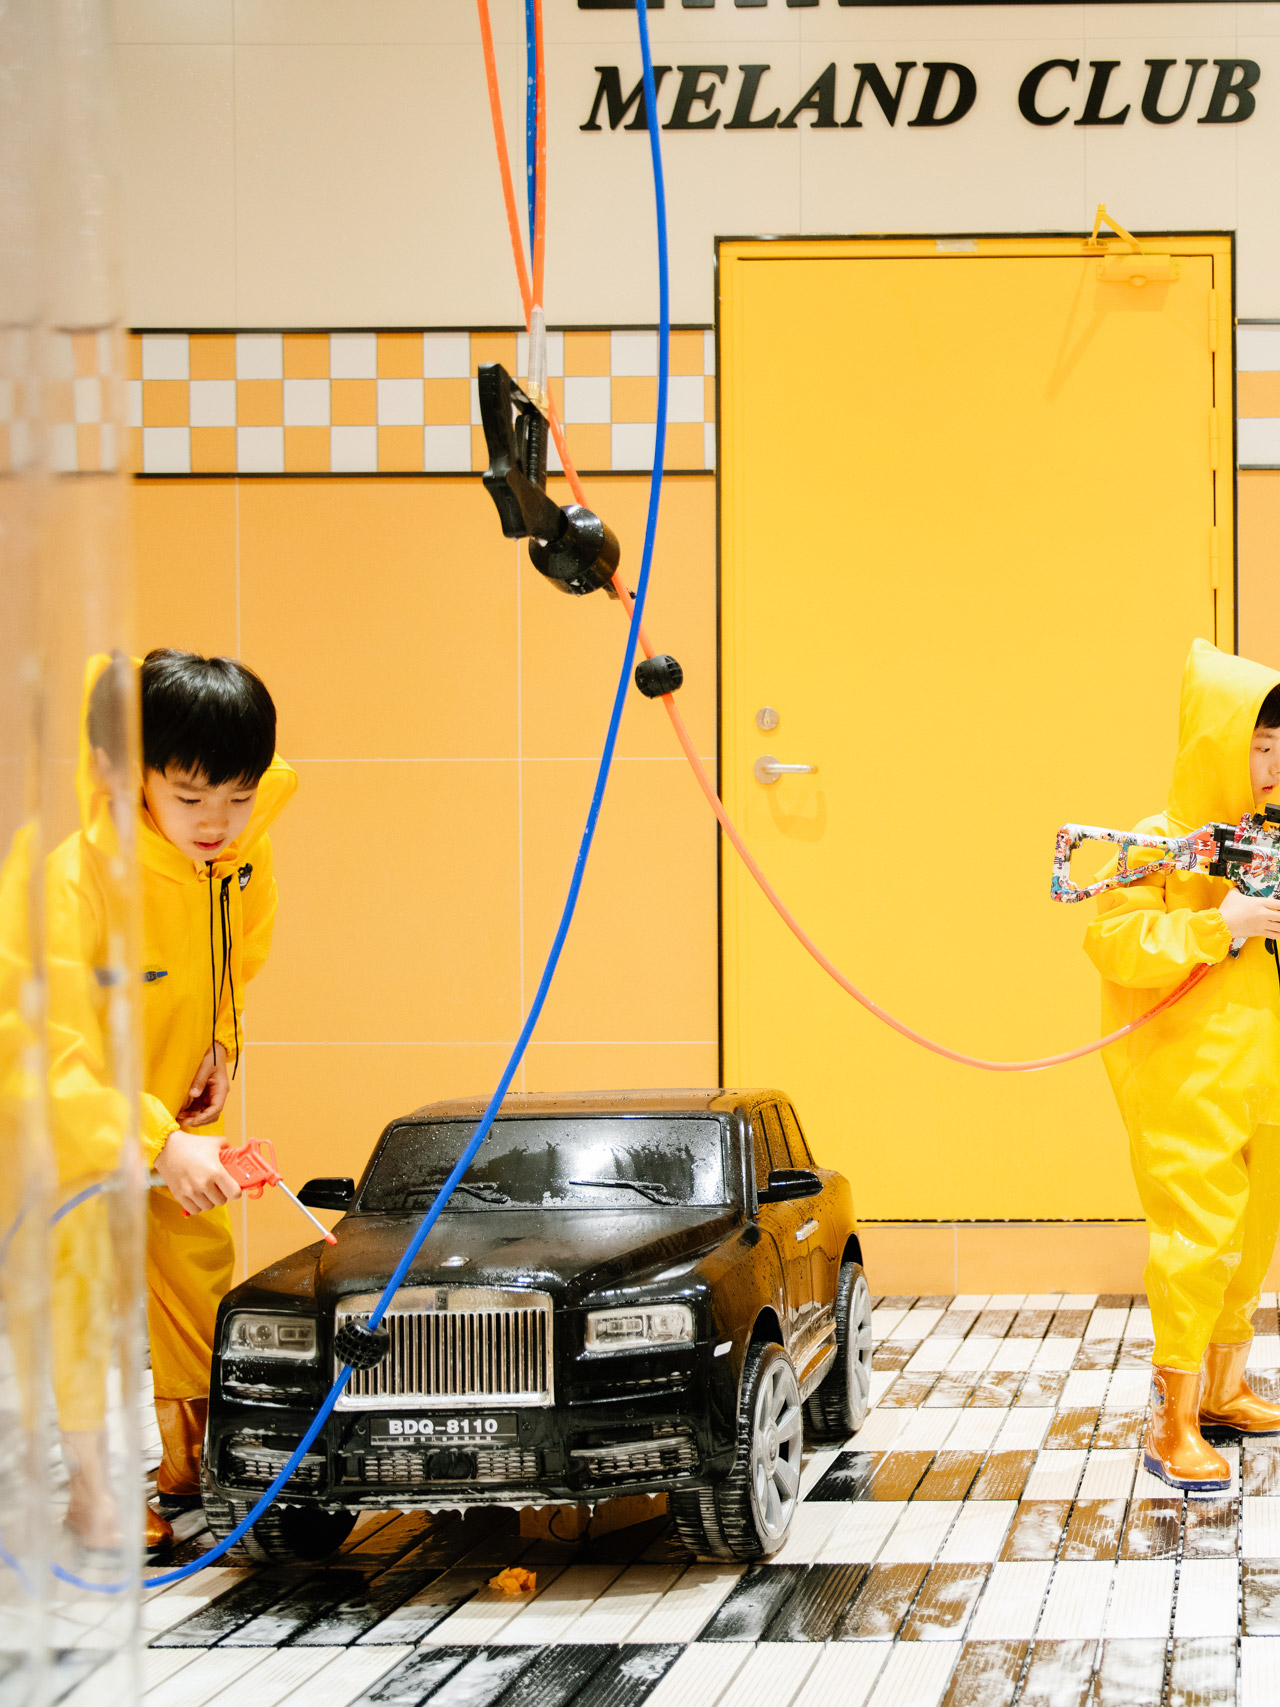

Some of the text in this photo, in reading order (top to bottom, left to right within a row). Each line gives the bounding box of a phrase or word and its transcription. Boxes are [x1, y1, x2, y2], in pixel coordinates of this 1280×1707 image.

[579, 58, 1261, 131] MELAND CLUB
[388, 1418, 498, 1435] BDQ-8110
